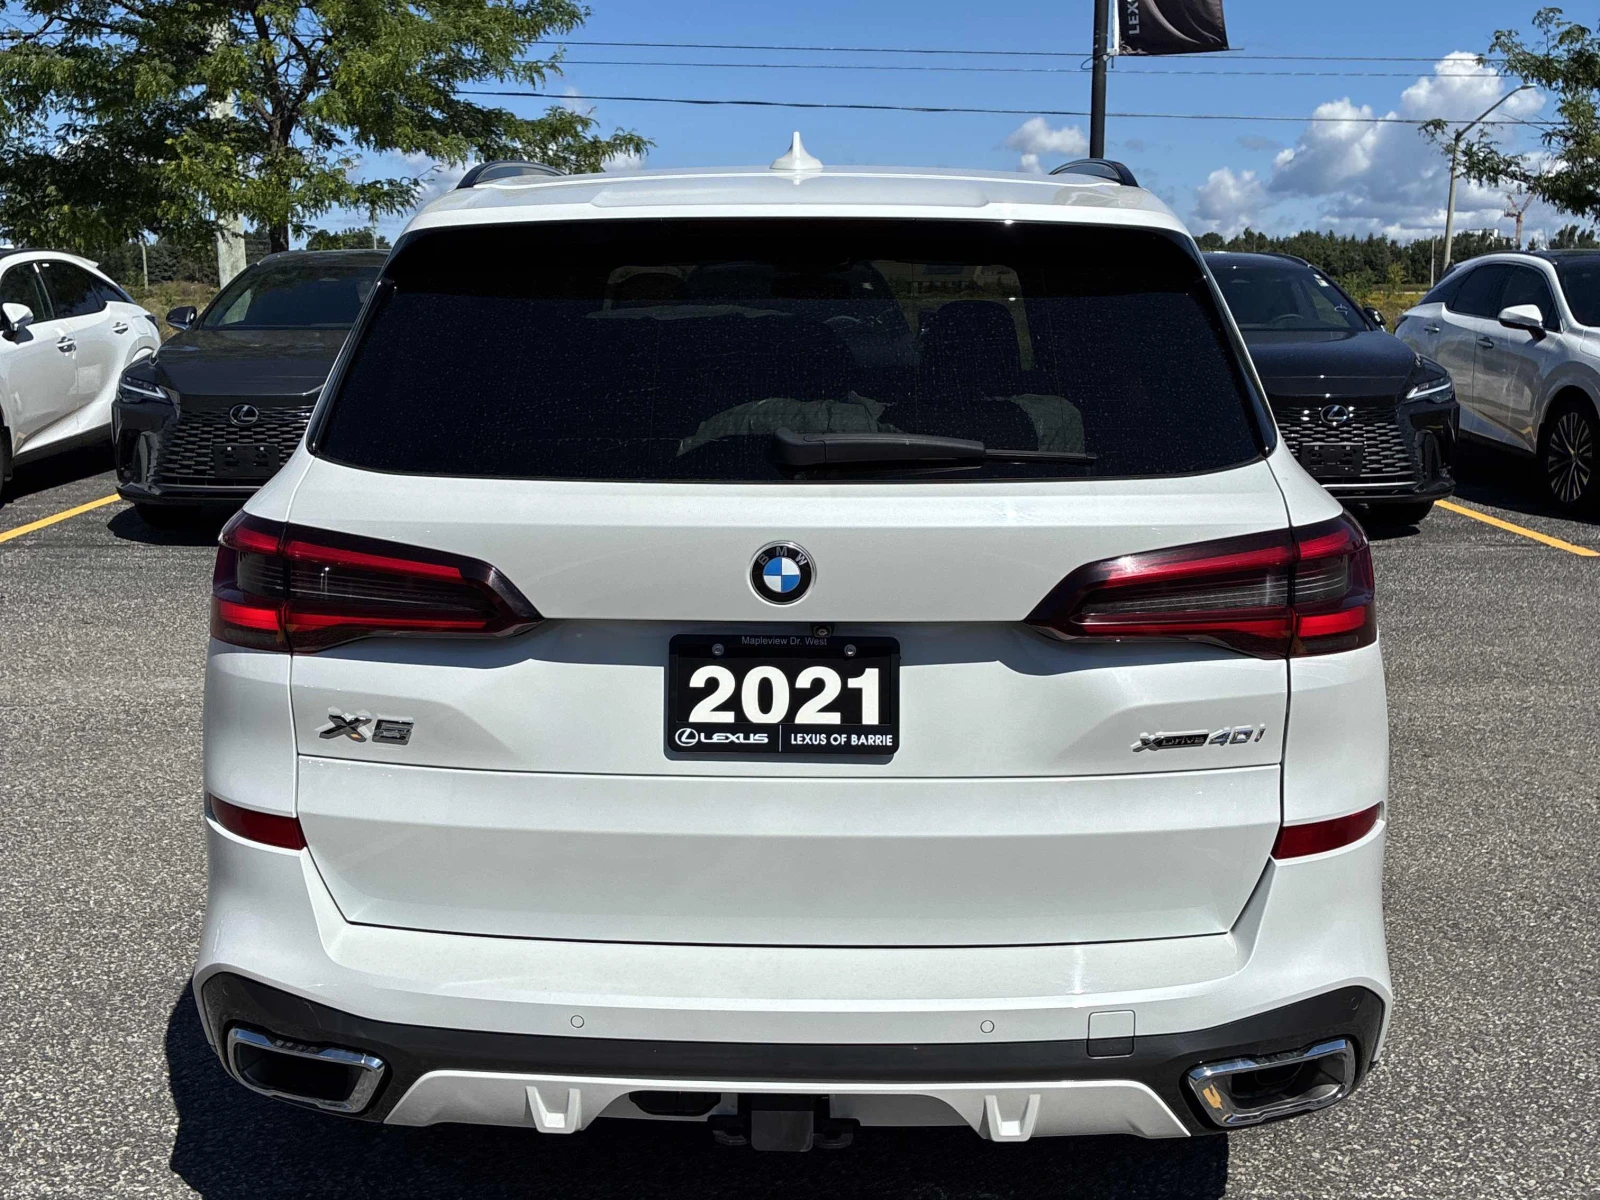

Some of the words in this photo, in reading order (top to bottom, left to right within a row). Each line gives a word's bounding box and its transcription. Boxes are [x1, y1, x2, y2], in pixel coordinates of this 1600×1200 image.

[1128, 0, 1140, 34] LEX
[757, 546, 808, 566] BMW
[741, 635, 788, 647] Mapleview
[789, 636, 802, 646] Dr.
[804, 636, 828, 646] West
[688, 665, 880, 725] 2021
[700, 732, 769, 744] LEXUS
[790, 733, 827, 745] LEXUS
[830, 734, 848, 745] OF
[850, 734, 893, 746] BARRIE
